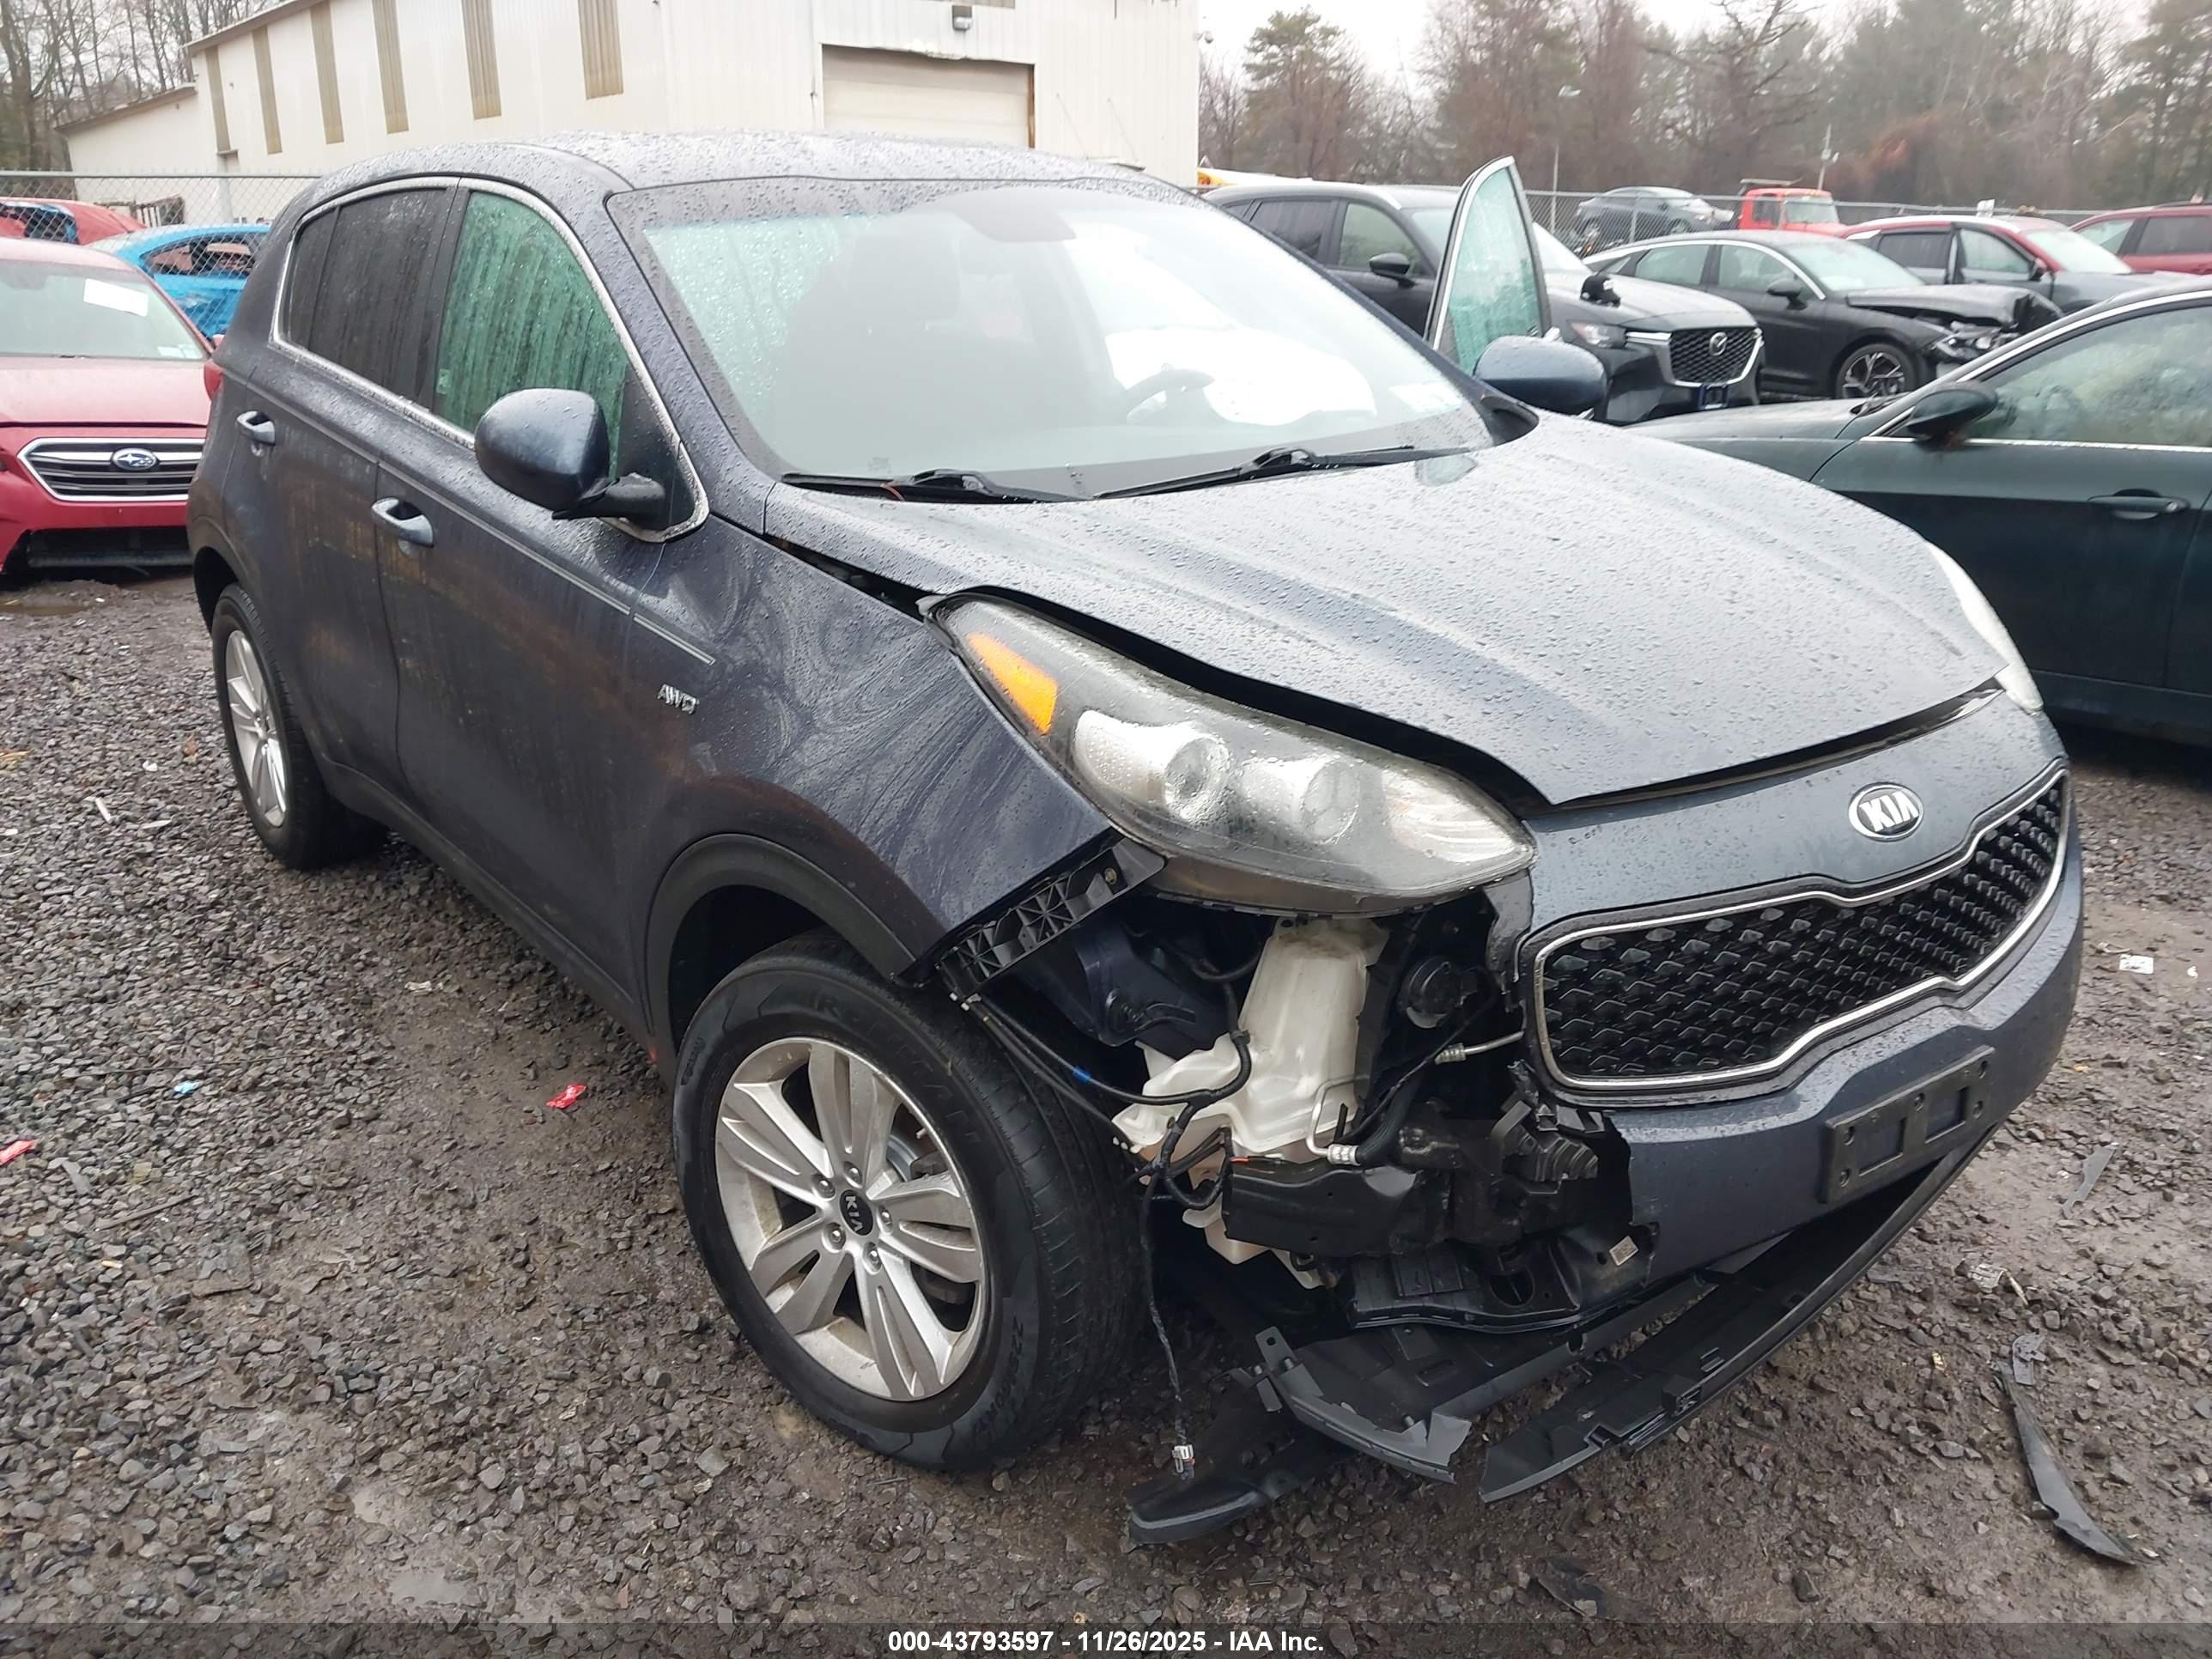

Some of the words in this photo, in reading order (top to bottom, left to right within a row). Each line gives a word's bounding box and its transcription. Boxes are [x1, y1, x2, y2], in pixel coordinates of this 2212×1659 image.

[657, 684, 697, 714] AWD
[1858, 791, 1920, 832] KIA
[845, 1195, 863, 1231] KIA
